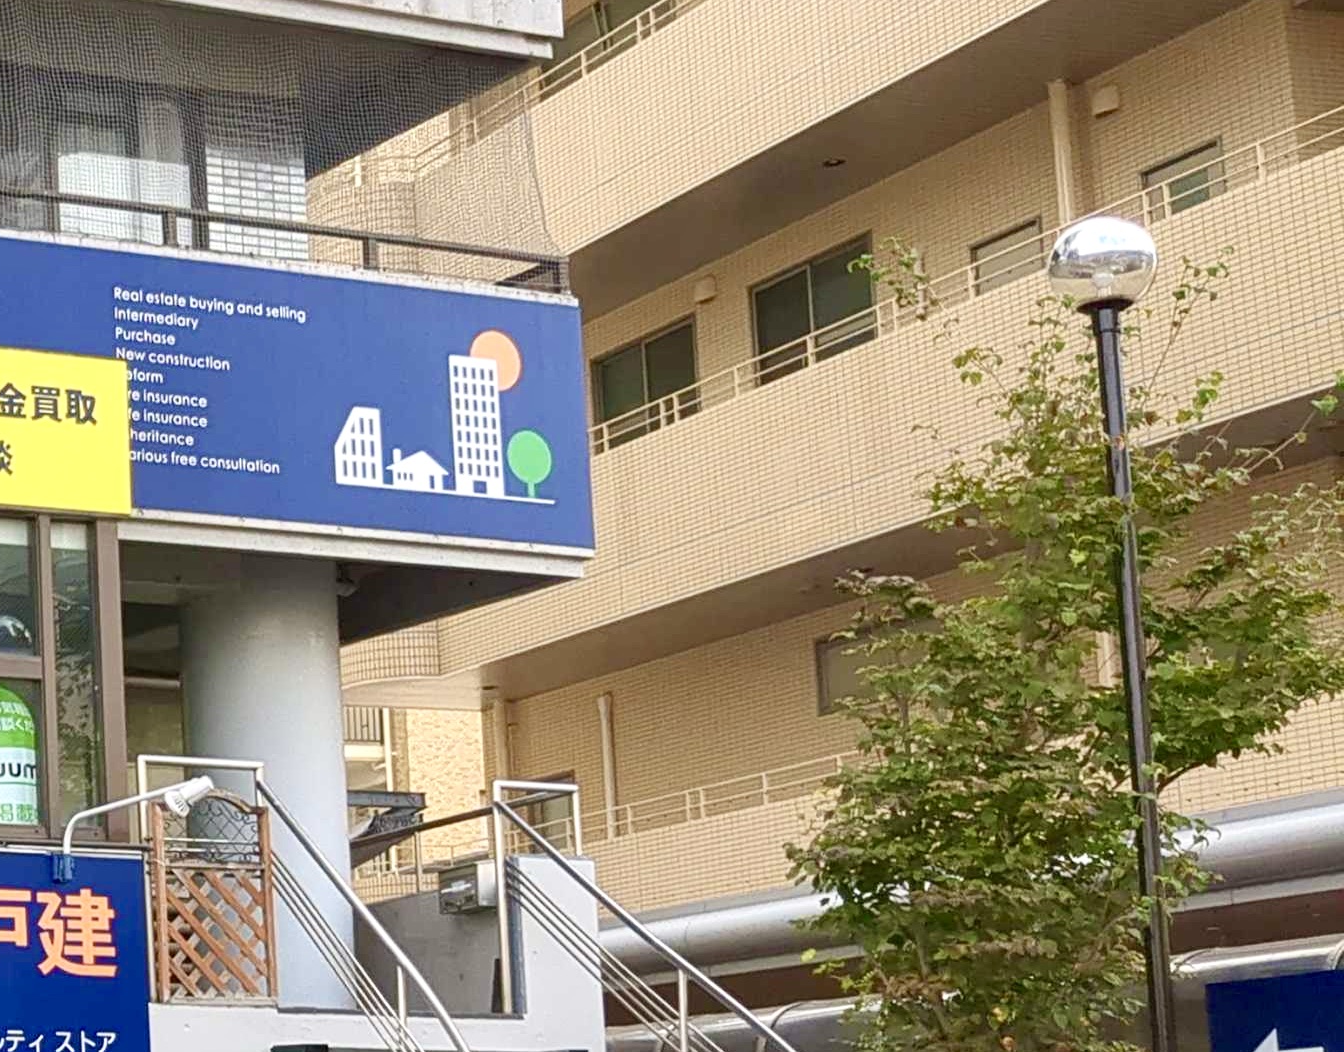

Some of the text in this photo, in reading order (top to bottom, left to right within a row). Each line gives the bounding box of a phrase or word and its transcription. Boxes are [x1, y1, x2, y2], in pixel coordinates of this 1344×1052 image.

[114, 287, 307, 324] Real estate buying and selling
[114, 307, 199, 330] Intermediary
[115, 327, 176, 346] Purchase
[116, 347, 230, 371] New construction
[143, 389, 207, 408] insurance
[143, 409, 208, 427] insurance
[129, 449, 280, 474] arious free consultation
